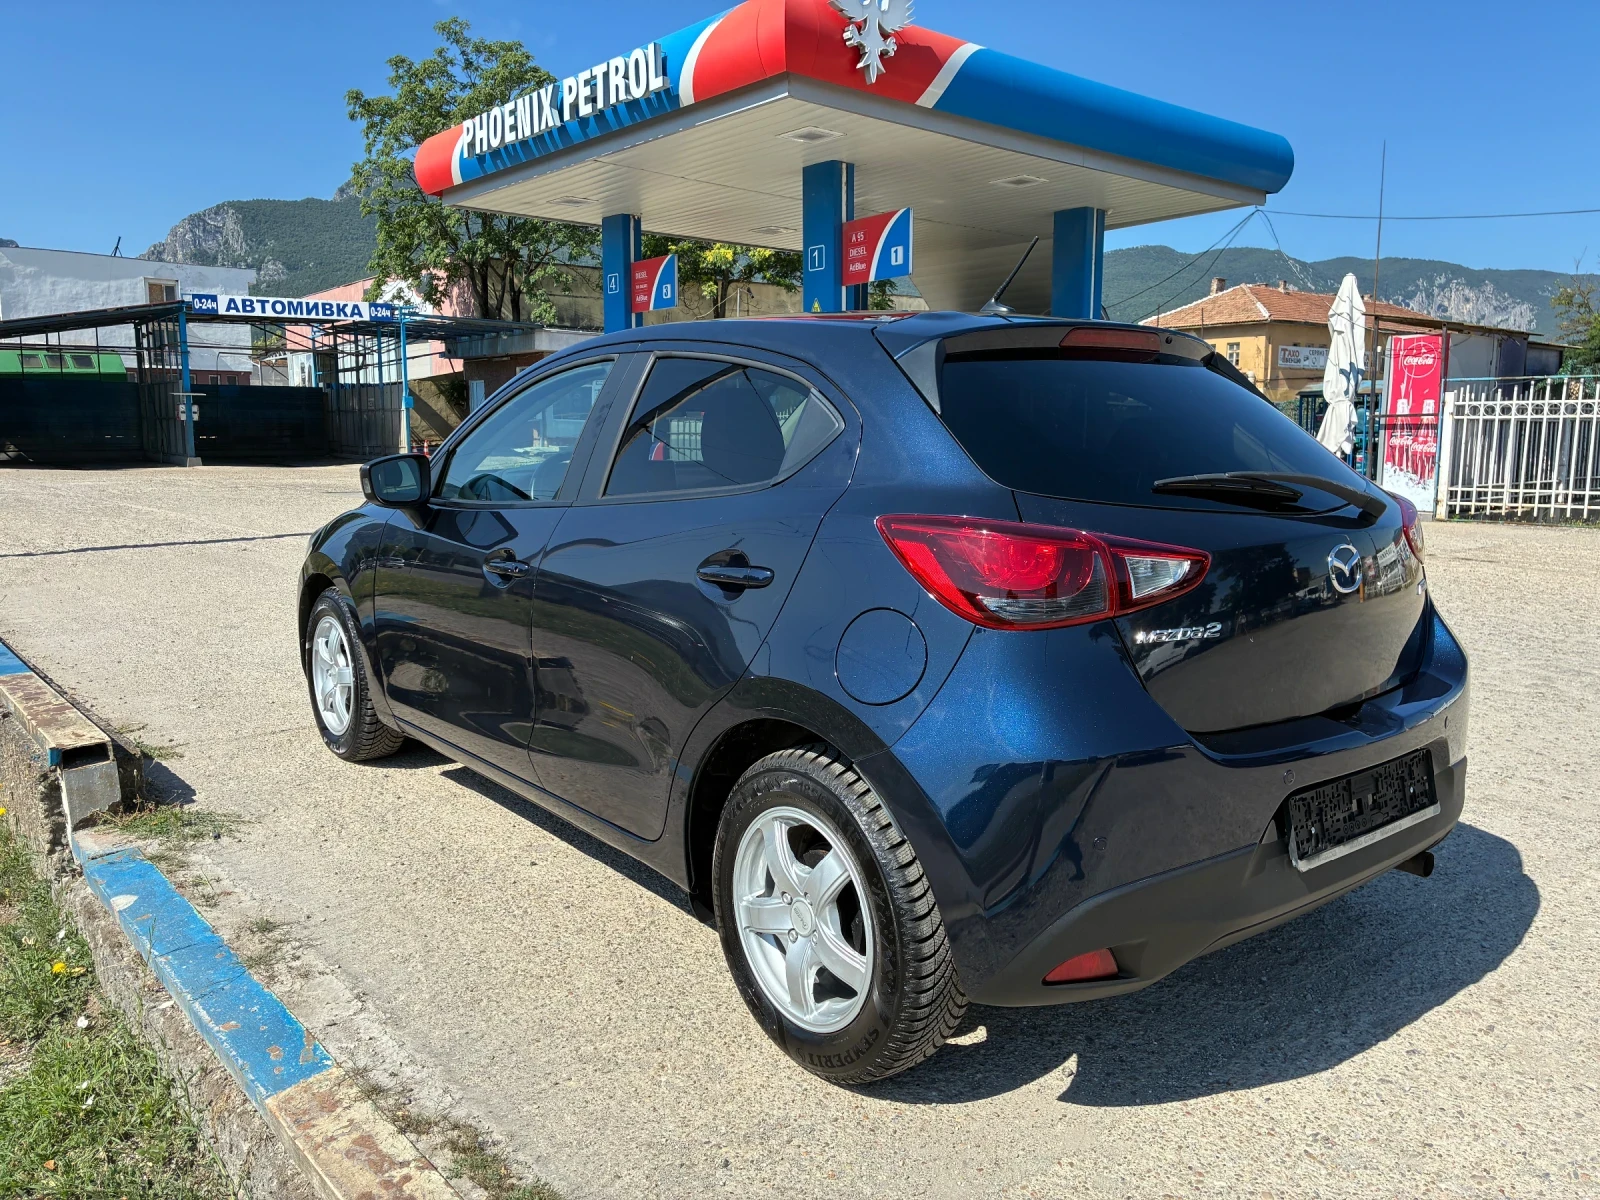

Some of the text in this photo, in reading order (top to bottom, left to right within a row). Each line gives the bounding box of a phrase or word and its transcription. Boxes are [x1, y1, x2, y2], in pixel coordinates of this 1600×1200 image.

[462, 42, 669, 159] PHOENIX PETROL
[857, 231, 865, 242] 95
[812, 249, 818, 267] 1
[849, 246, 867, 257] DIESEL
[849, 262, 867, 272] AdBlue
[610, 276, 616, 290] 4
[193, 298, 217, 310] 0-24ч
[225, 297, 364, 318] АВТОМИВКА
[370, 306, 391, 317] 0-24ч
[1404, 353, 1435, 366] Coca-Cola
[807, 1027, 880, 1069] SEMPERIT
